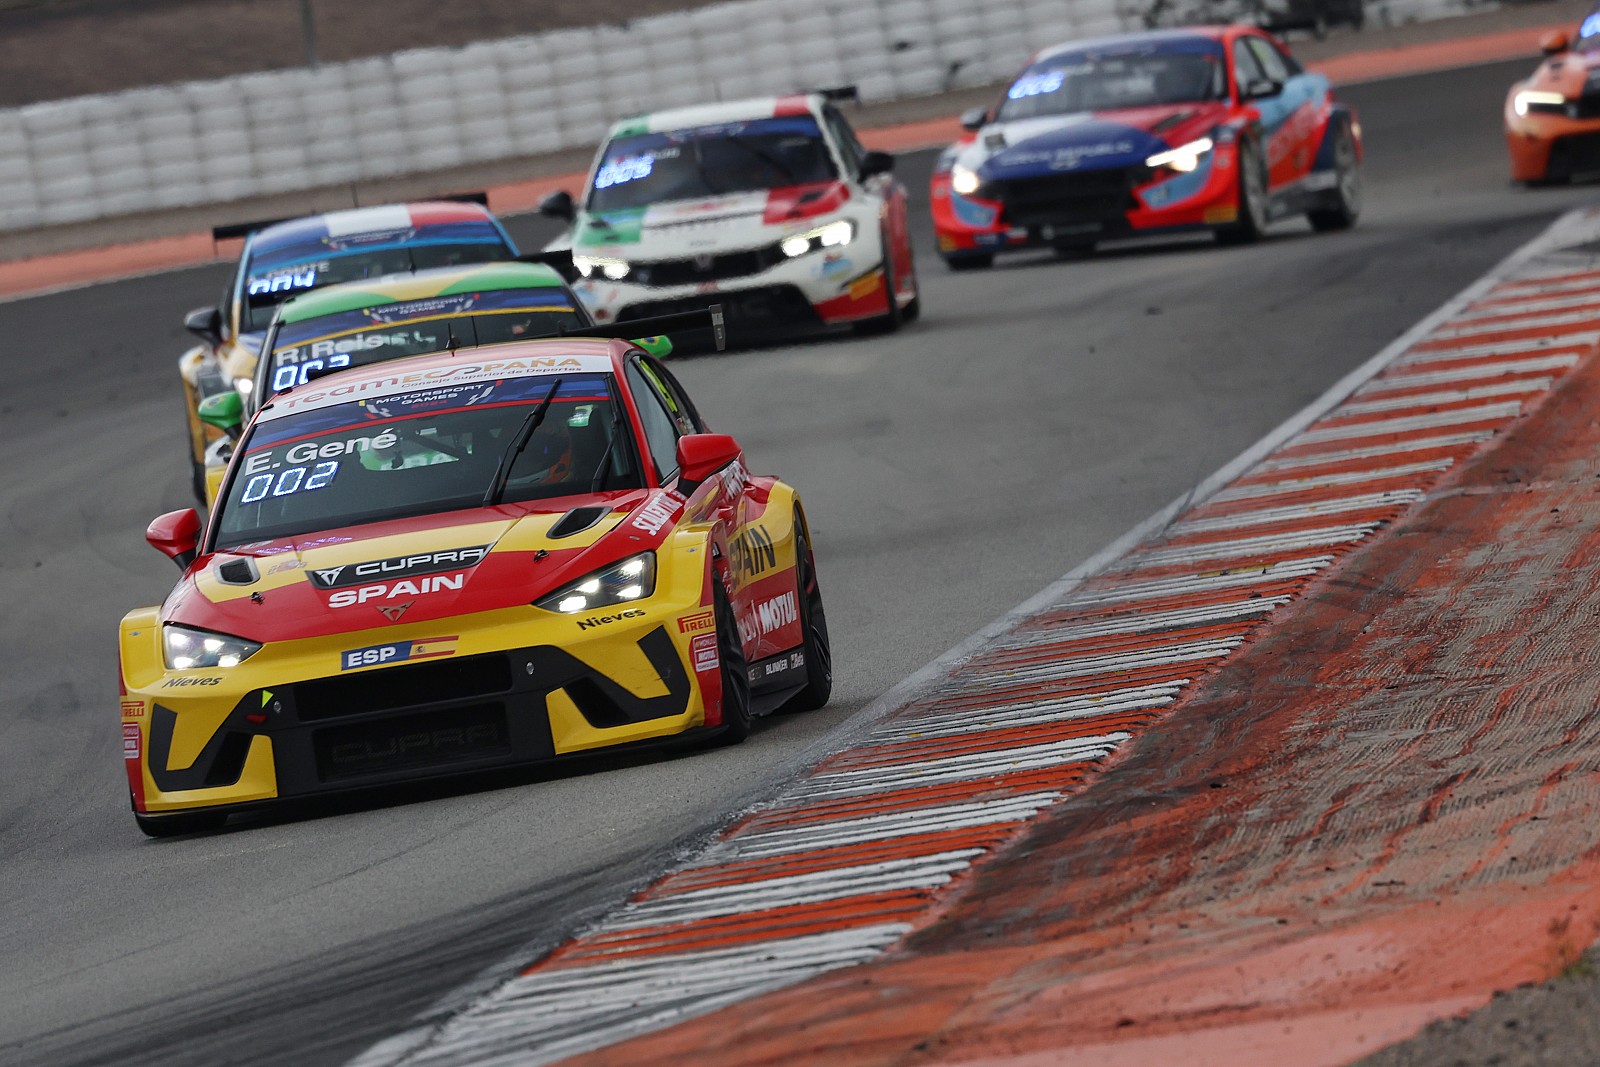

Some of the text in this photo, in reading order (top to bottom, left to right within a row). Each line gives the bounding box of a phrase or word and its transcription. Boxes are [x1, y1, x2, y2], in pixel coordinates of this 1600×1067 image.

[401, 376, 450, 388] Consejo
[453, 370, 504, 381] Superior
[526, 366, 582, 374] Deportes
[376, 384, 485, 404] MOTORSPORT
[401, 392, 458, 405] GAMES
[244, 451, 281, 476] E.
[285, 427, 398, 464] Gené
[241, 460, 339, 503] 002
[355, 548, 486, 576] CUPRA
[328, 573, 464, 608] SPAIN
[577, 608, 646, 631] Nieves
[677, 611, 716, 633] PIRELLI
[758, 591, 797, 635] MOTUL
[347, 646, 397, 668] ESP
[161, 674, 223, 689] Nieves
